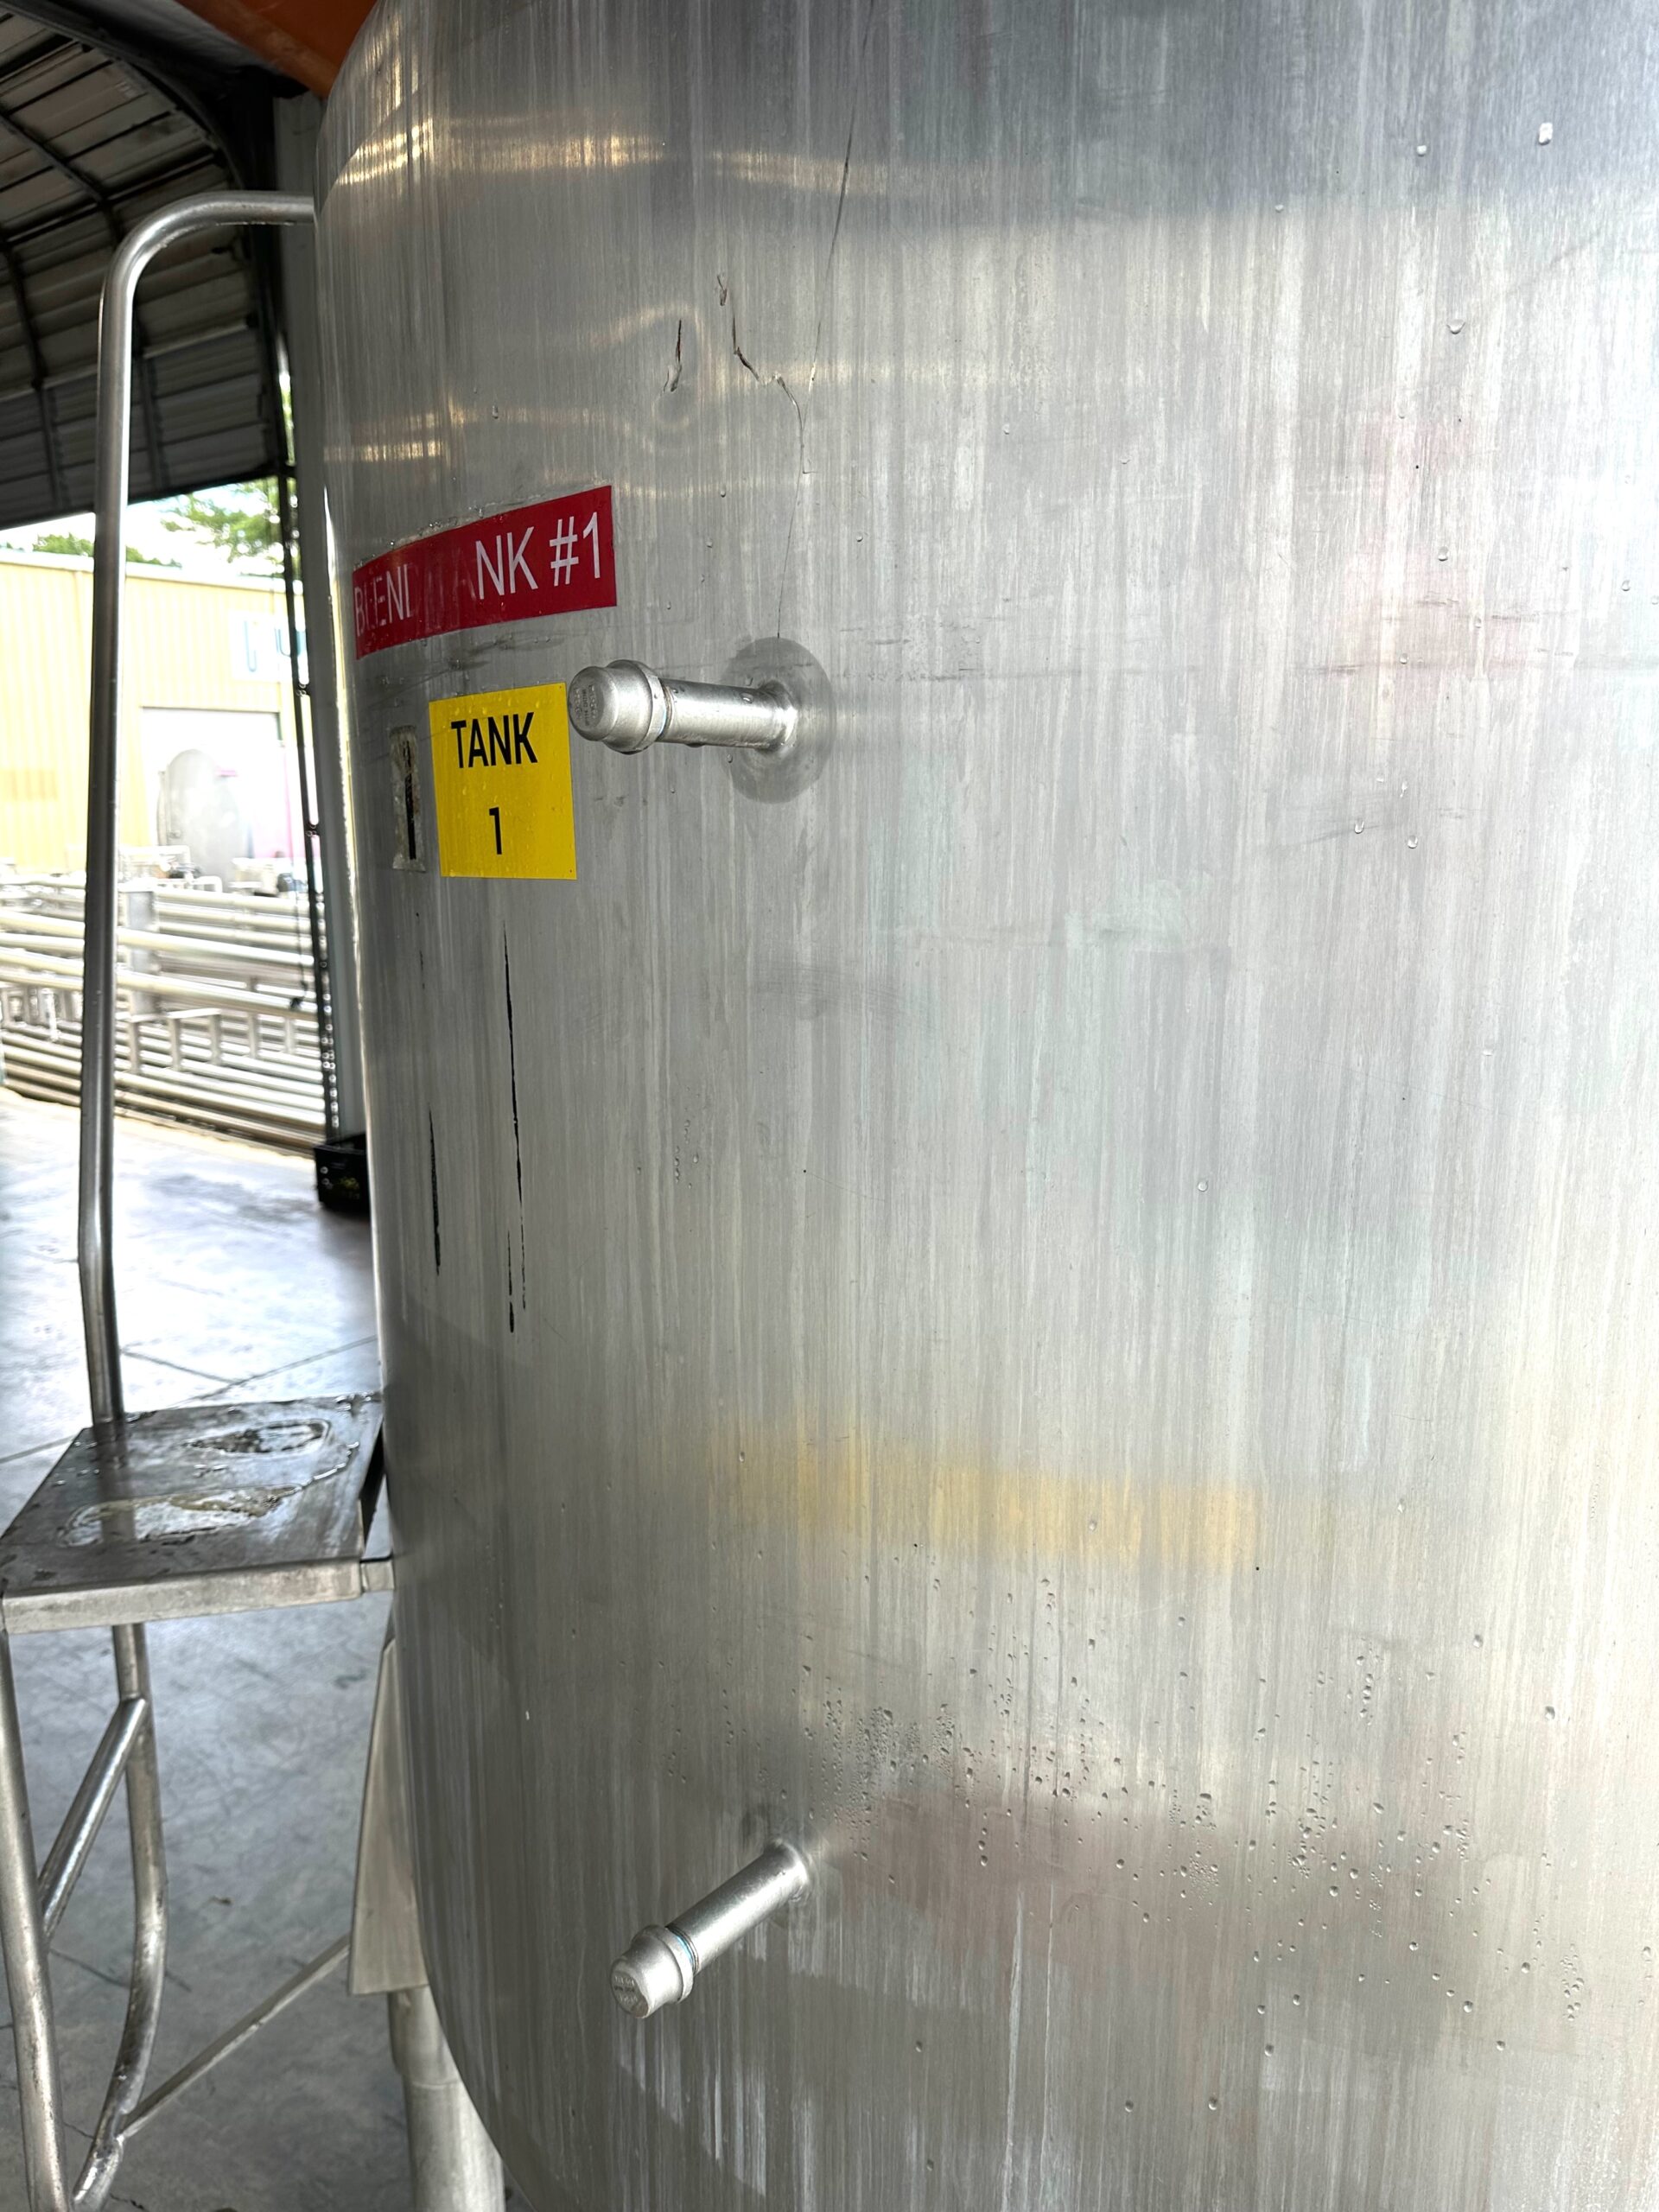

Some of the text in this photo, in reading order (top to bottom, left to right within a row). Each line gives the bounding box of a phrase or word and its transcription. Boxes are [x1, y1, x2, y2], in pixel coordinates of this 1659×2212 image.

[550, 512, 601, 586] #1
[451, 712, 538, 768] TANK
[489, 807, 502, 855] 1
